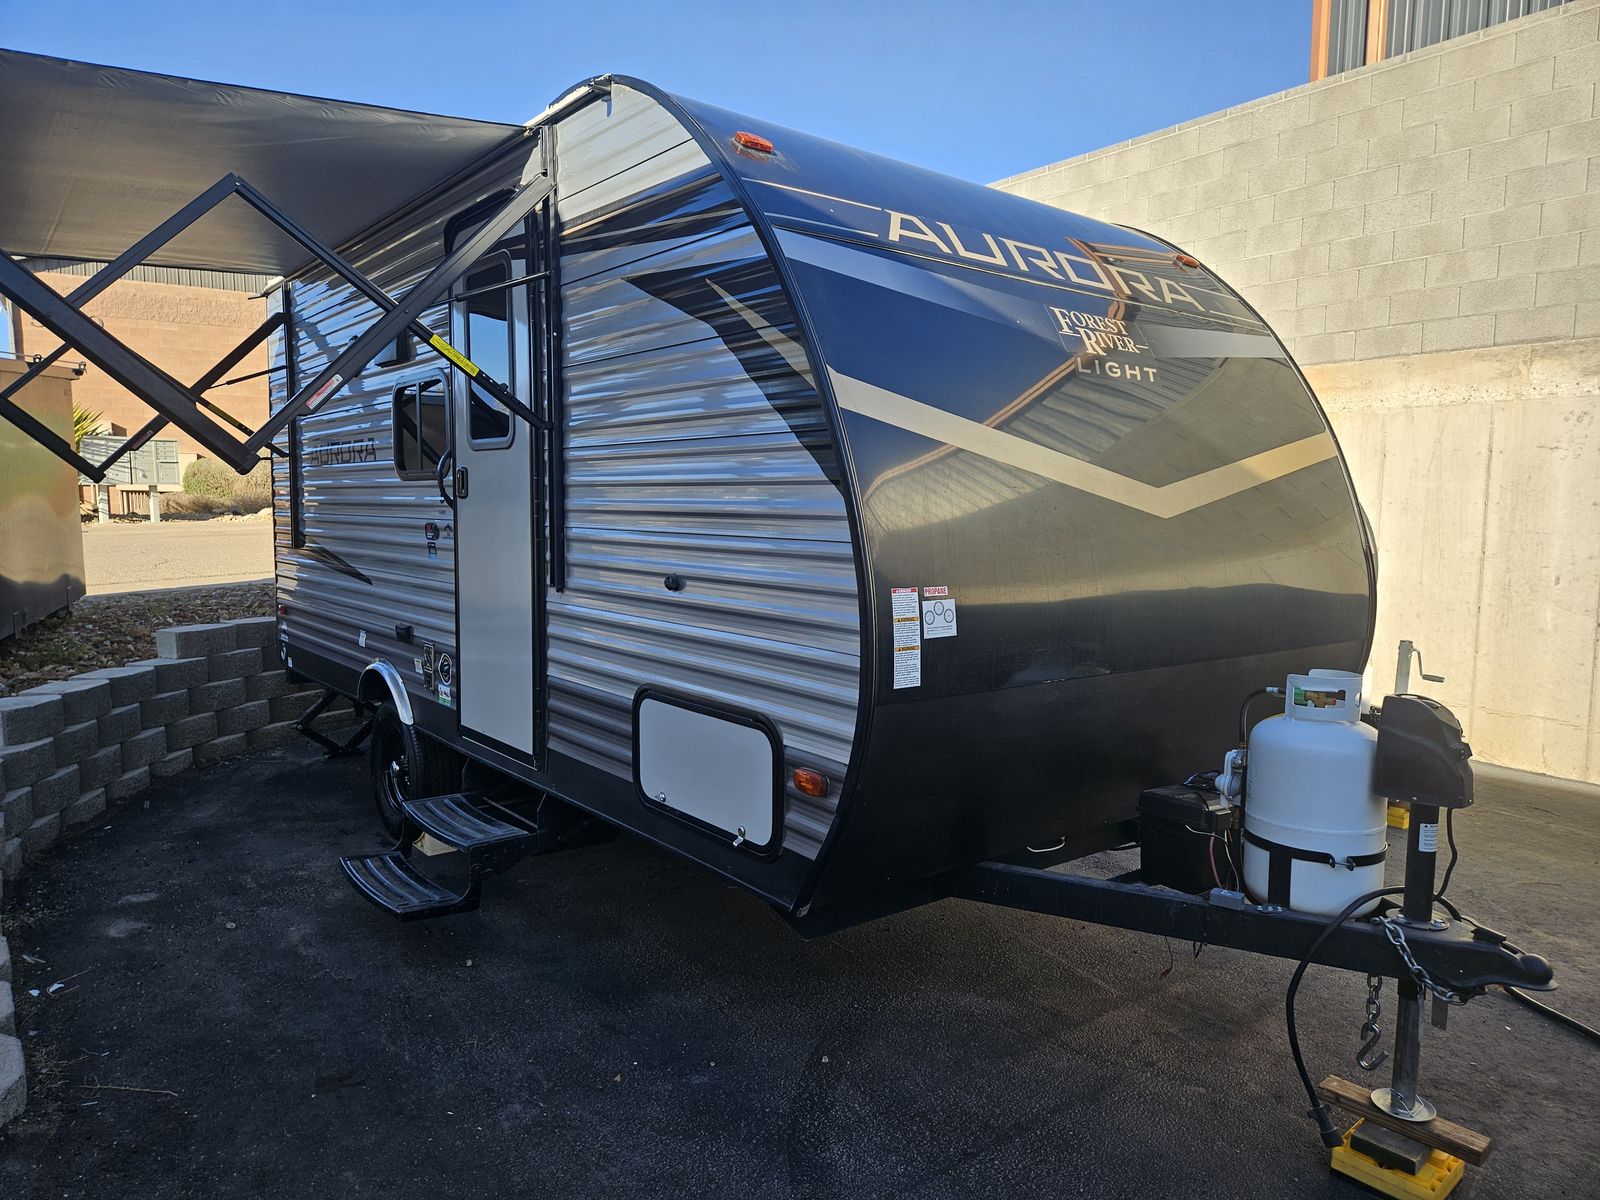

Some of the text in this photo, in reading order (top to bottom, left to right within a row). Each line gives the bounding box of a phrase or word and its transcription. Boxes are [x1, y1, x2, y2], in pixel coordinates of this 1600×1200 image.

[884, 208, 1207, 312] AURORA
[1050, 306, 1129, 335] FOREST
[1077, 327, 1140, 357] RIVER
[1077, 357, 1158, 384] LIGHT
[924, 587, 948, 595] PROPANE
